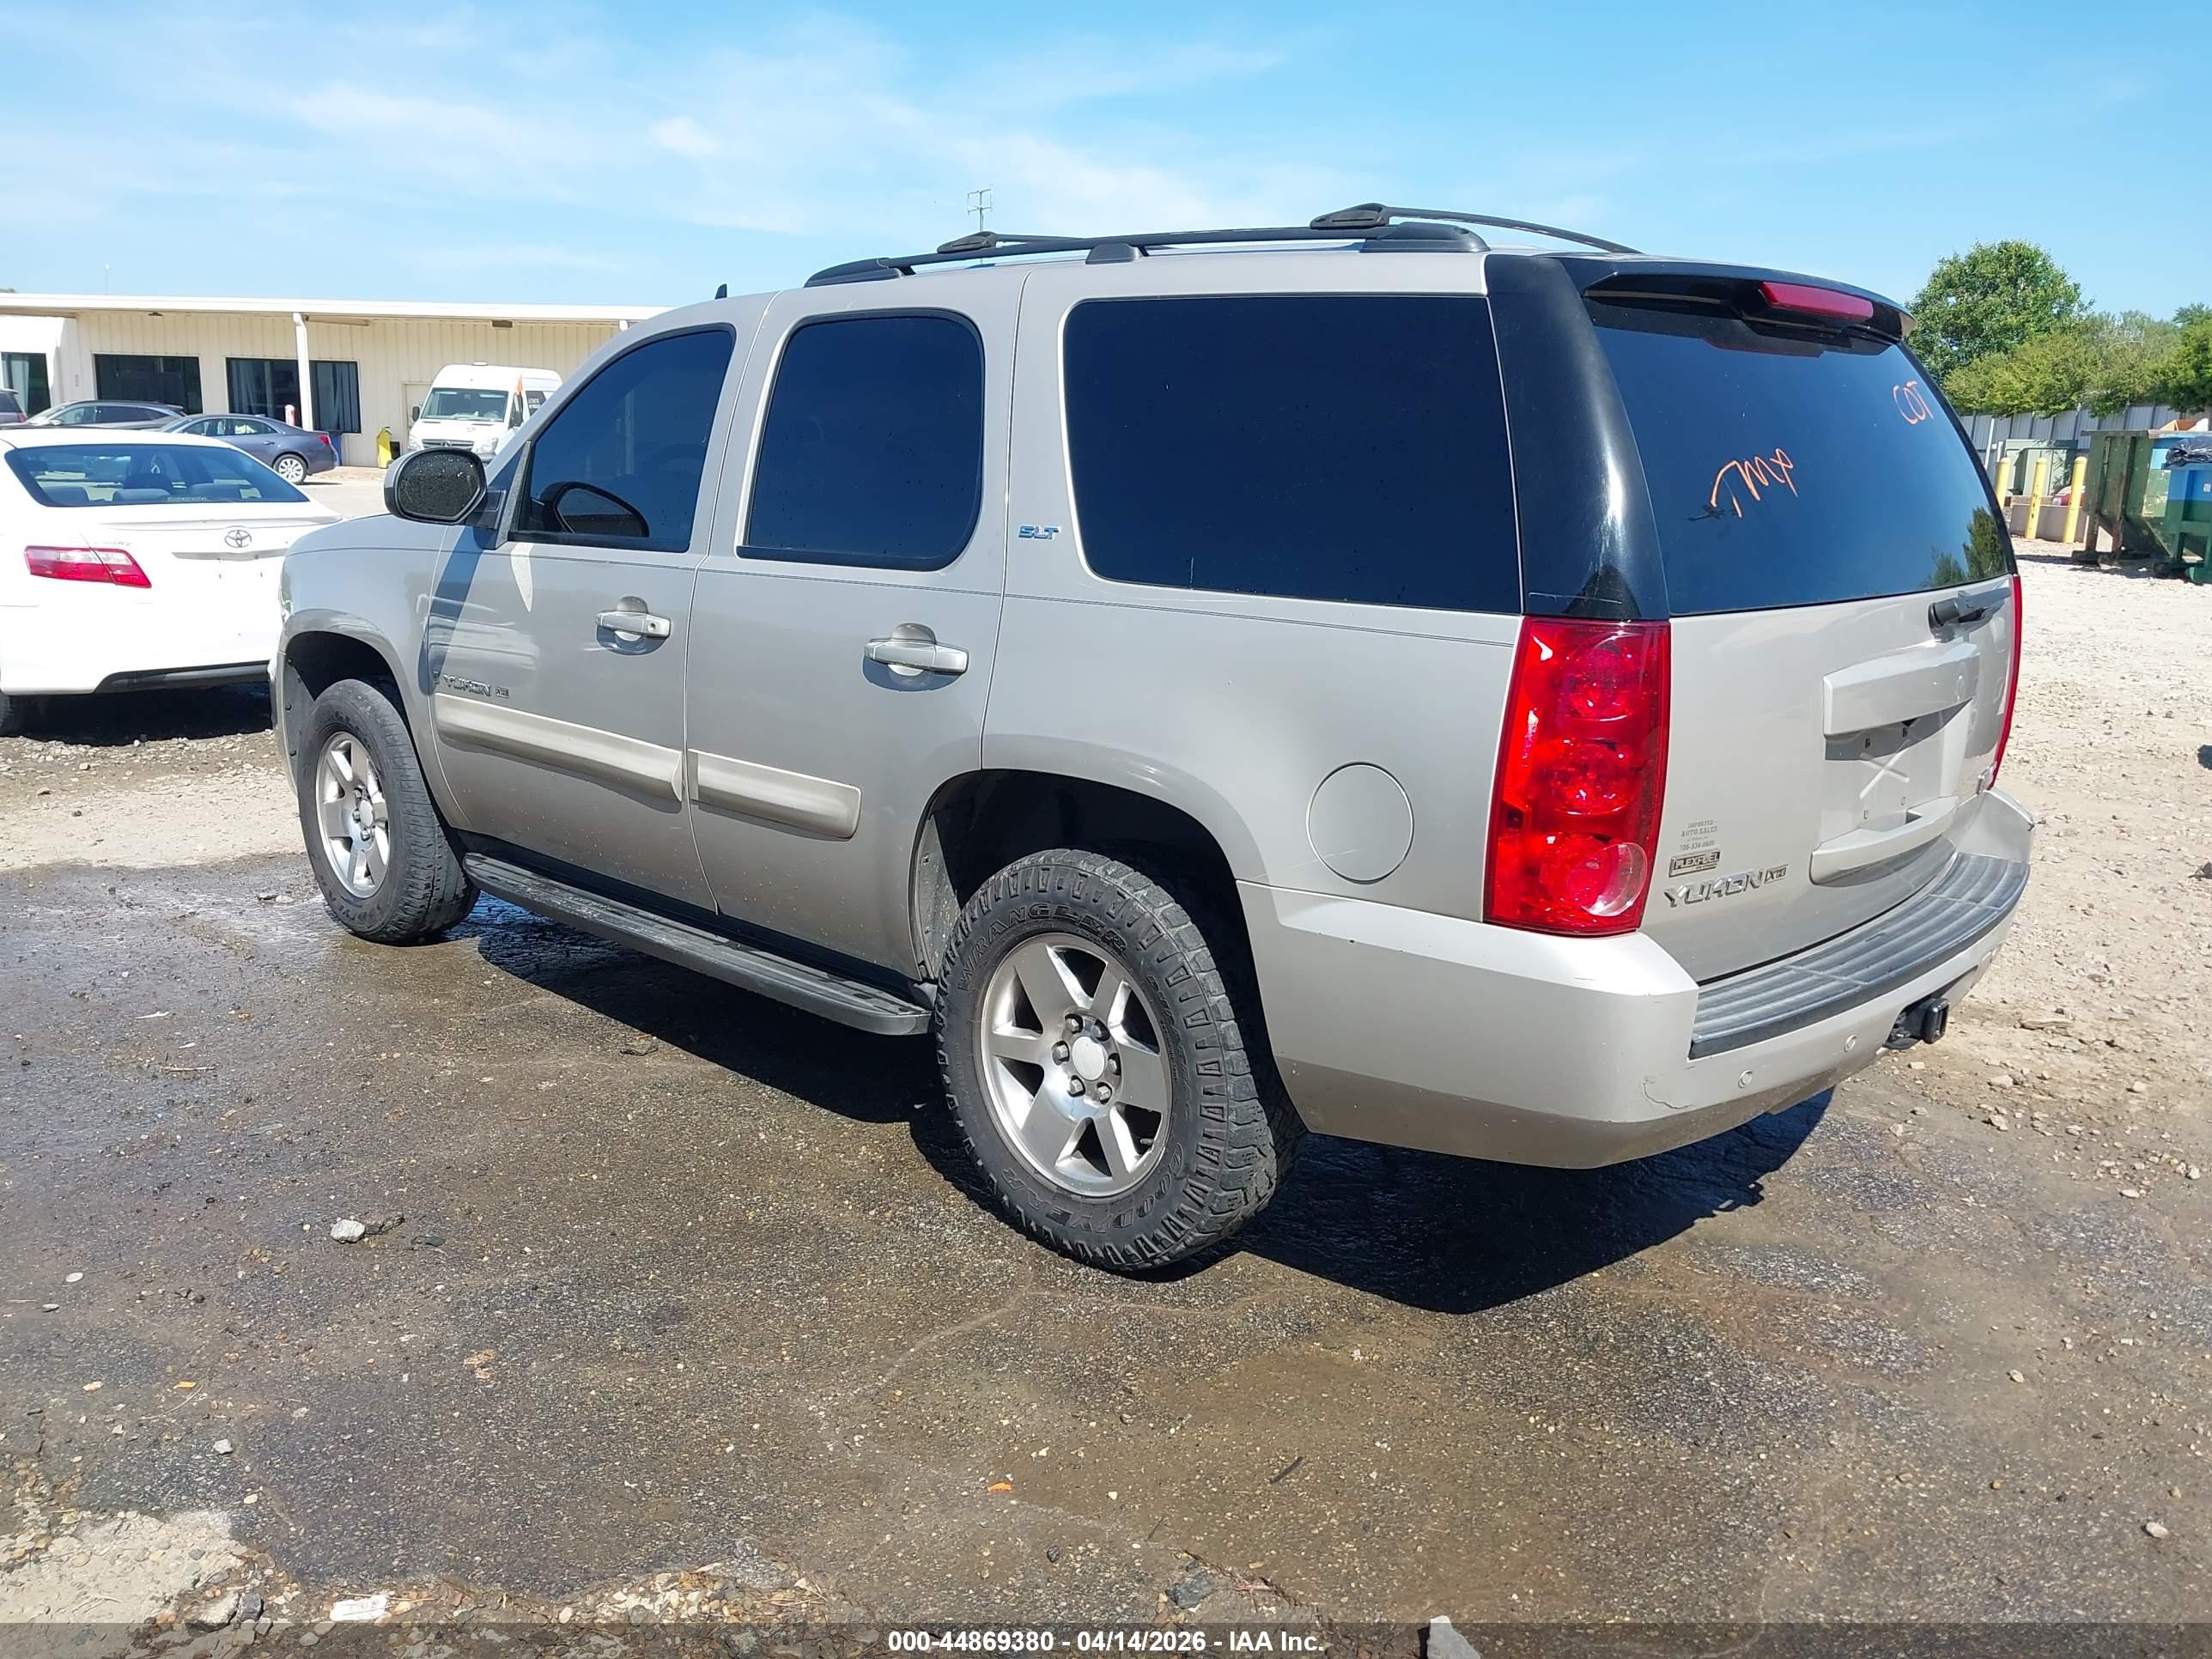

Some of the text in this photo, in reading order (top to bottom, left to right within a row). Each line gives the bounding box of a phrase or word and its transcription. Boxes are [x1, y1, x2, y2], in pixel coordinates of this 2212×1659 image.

[1018, 525, 1060, 540] SLT
[1663, 869, 1763, 908] YUKON
[957, 902, 1127, 992] WRANGLER
[1001, 1142, 1184, 1234] GOODYEAR
